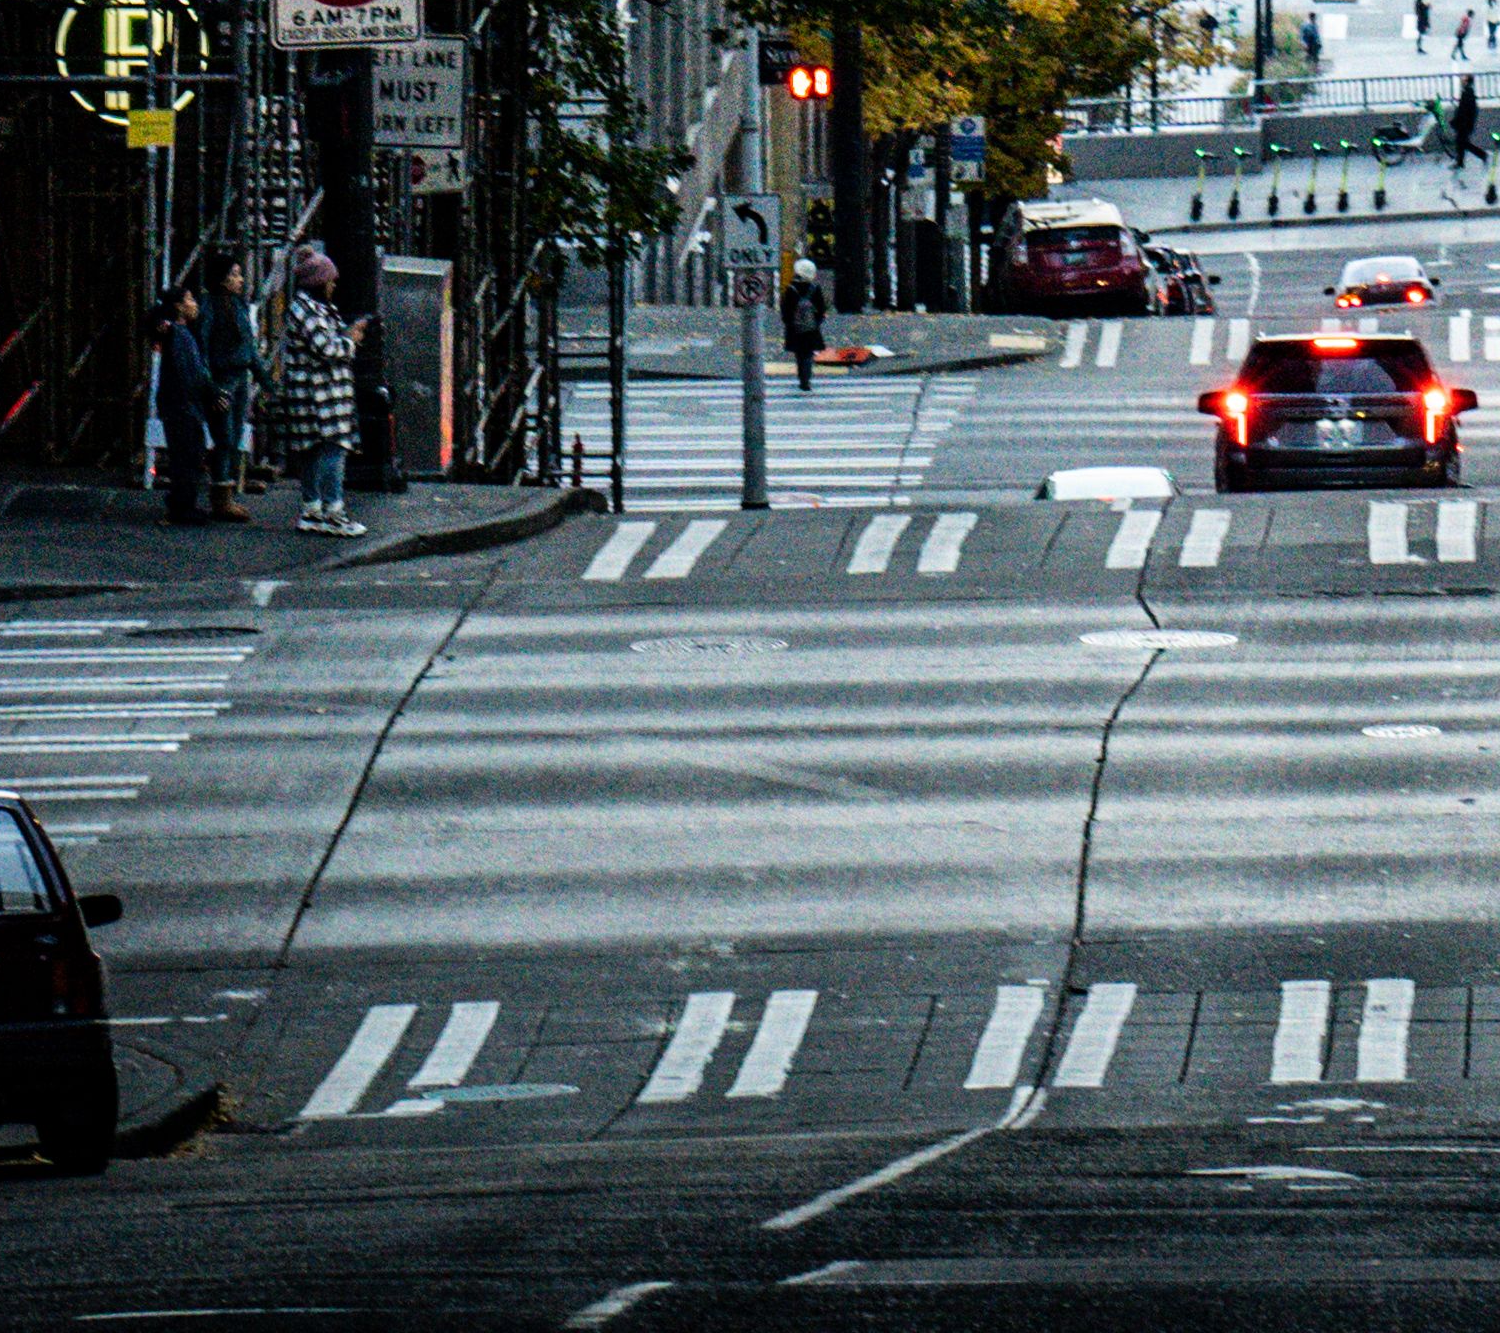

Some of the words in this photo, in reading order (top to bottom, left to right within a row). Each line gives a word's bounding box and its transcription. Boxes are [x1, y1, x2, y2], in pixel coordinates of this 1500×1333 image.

[372, 51, 404, 66] EFT
[413, 51, 458, 68] LANE
[380, 80, 438, 102] MUST
[415, 115, 455, 133] LEFT
[729, 249, 774, 265] ONLY
